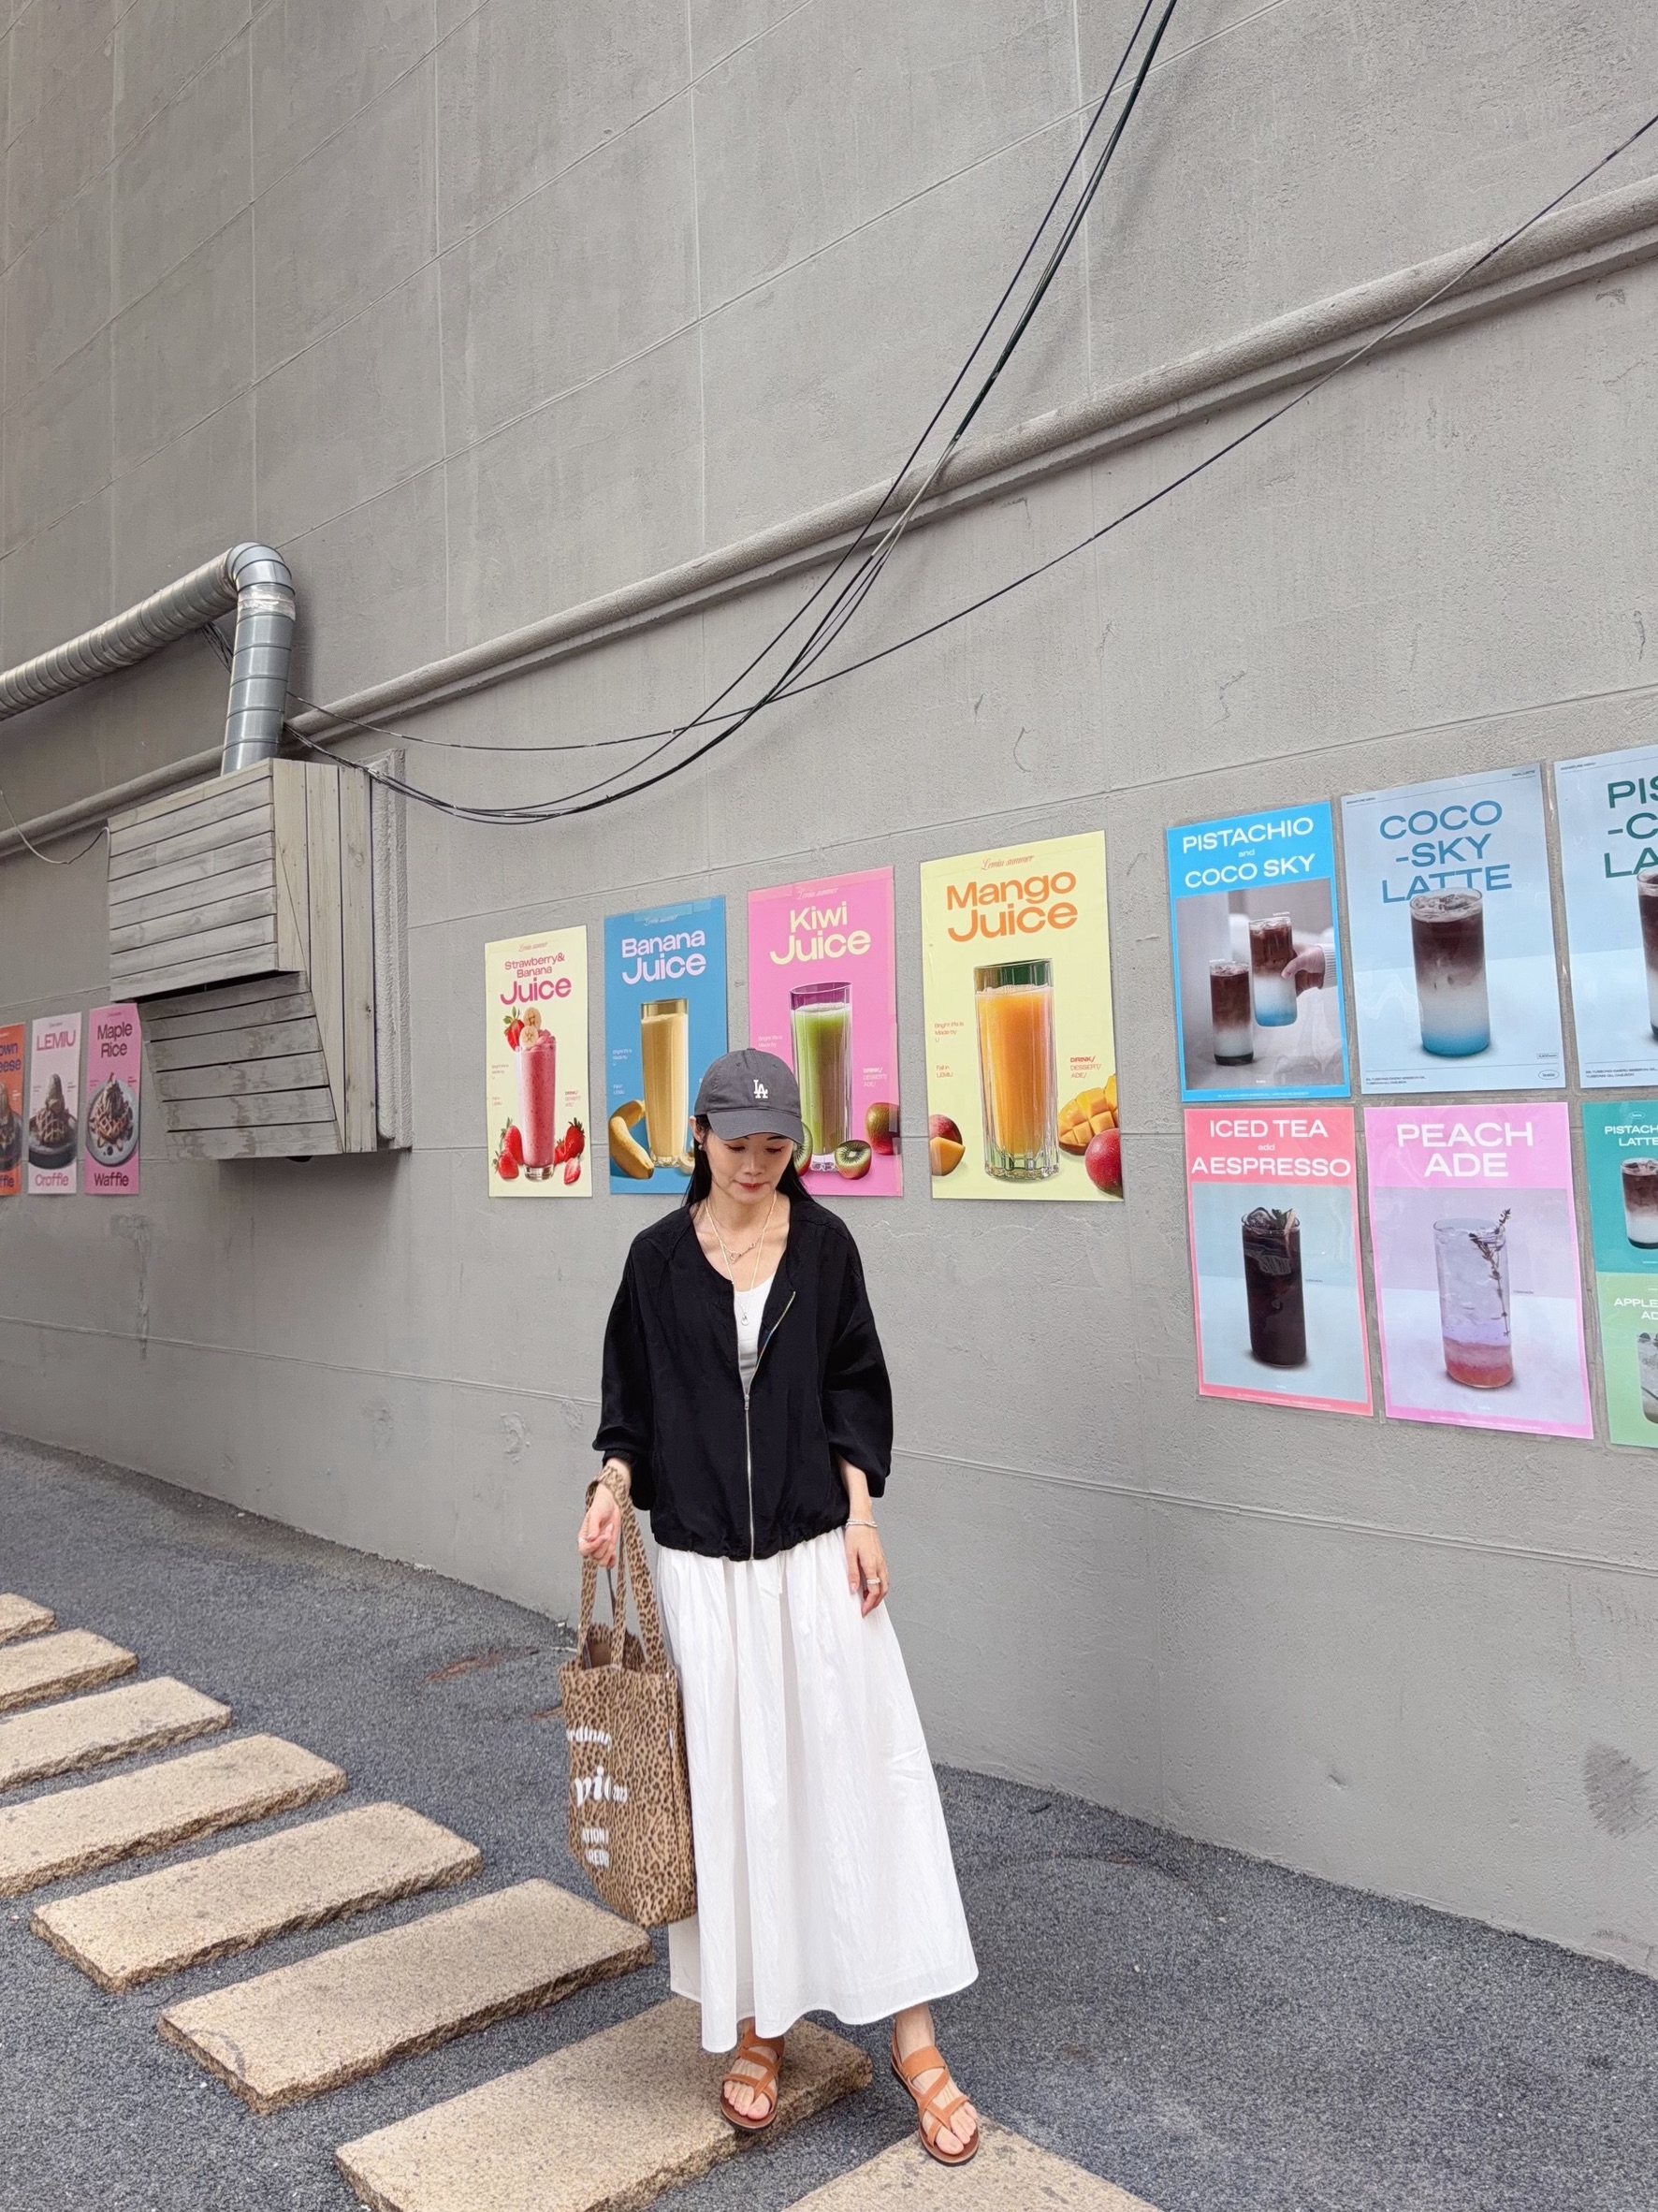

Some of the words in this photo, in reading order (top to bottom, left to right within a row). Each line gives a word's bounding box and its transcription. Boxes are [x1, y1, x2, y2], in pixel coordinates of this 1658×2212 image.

[1379, 800, 1503, 840] COCO
[1183, 817, 1314, 854] PISTACHIO
[1238, 849, 1256, 858] and
[1395, 833, 1491, 867] -SKY
[1185, 863, 1258, 888] COCO
[1263, 853, 1316, 878] SKY
[946, 871, 1077, 910] Mango
[1382, 864, 1512, 904] LATTE
[790, 900, 848, 933] Kiwi
[948, 902, 1079, 942] Juice
[621, 930, 705, 958] Banana
[769, 929, 871, 965] Juice
[516, 966, 553, 979] Banana
[621, 953, 706, 985] Juice
[500, 977, 572, 1006] Juice
[36, 1029, 77, 1051] LEMIU
[97, 1022, 133, 1041] Maple
[101, 1041, 127, 1058] Rice
[753, 1079, 768, 1099] LA
[1210, 1120, 1269, 1138] ICED
[1273, 1119, 1329, 1138] TEA
[1397, 1122, 1534, 1147] PEACH
[1619, 1137, 1658, 1146] LATTE
[1191, 1157, 1351, 1177] AESPRESSO
[1424, 1153, 1509, 1177] ADE
[36, 1172, 69, 1186] Croffle
[94, 1171, 129, 1186] Waffle
[1614, 1298, 1658, 1307] APPLE
